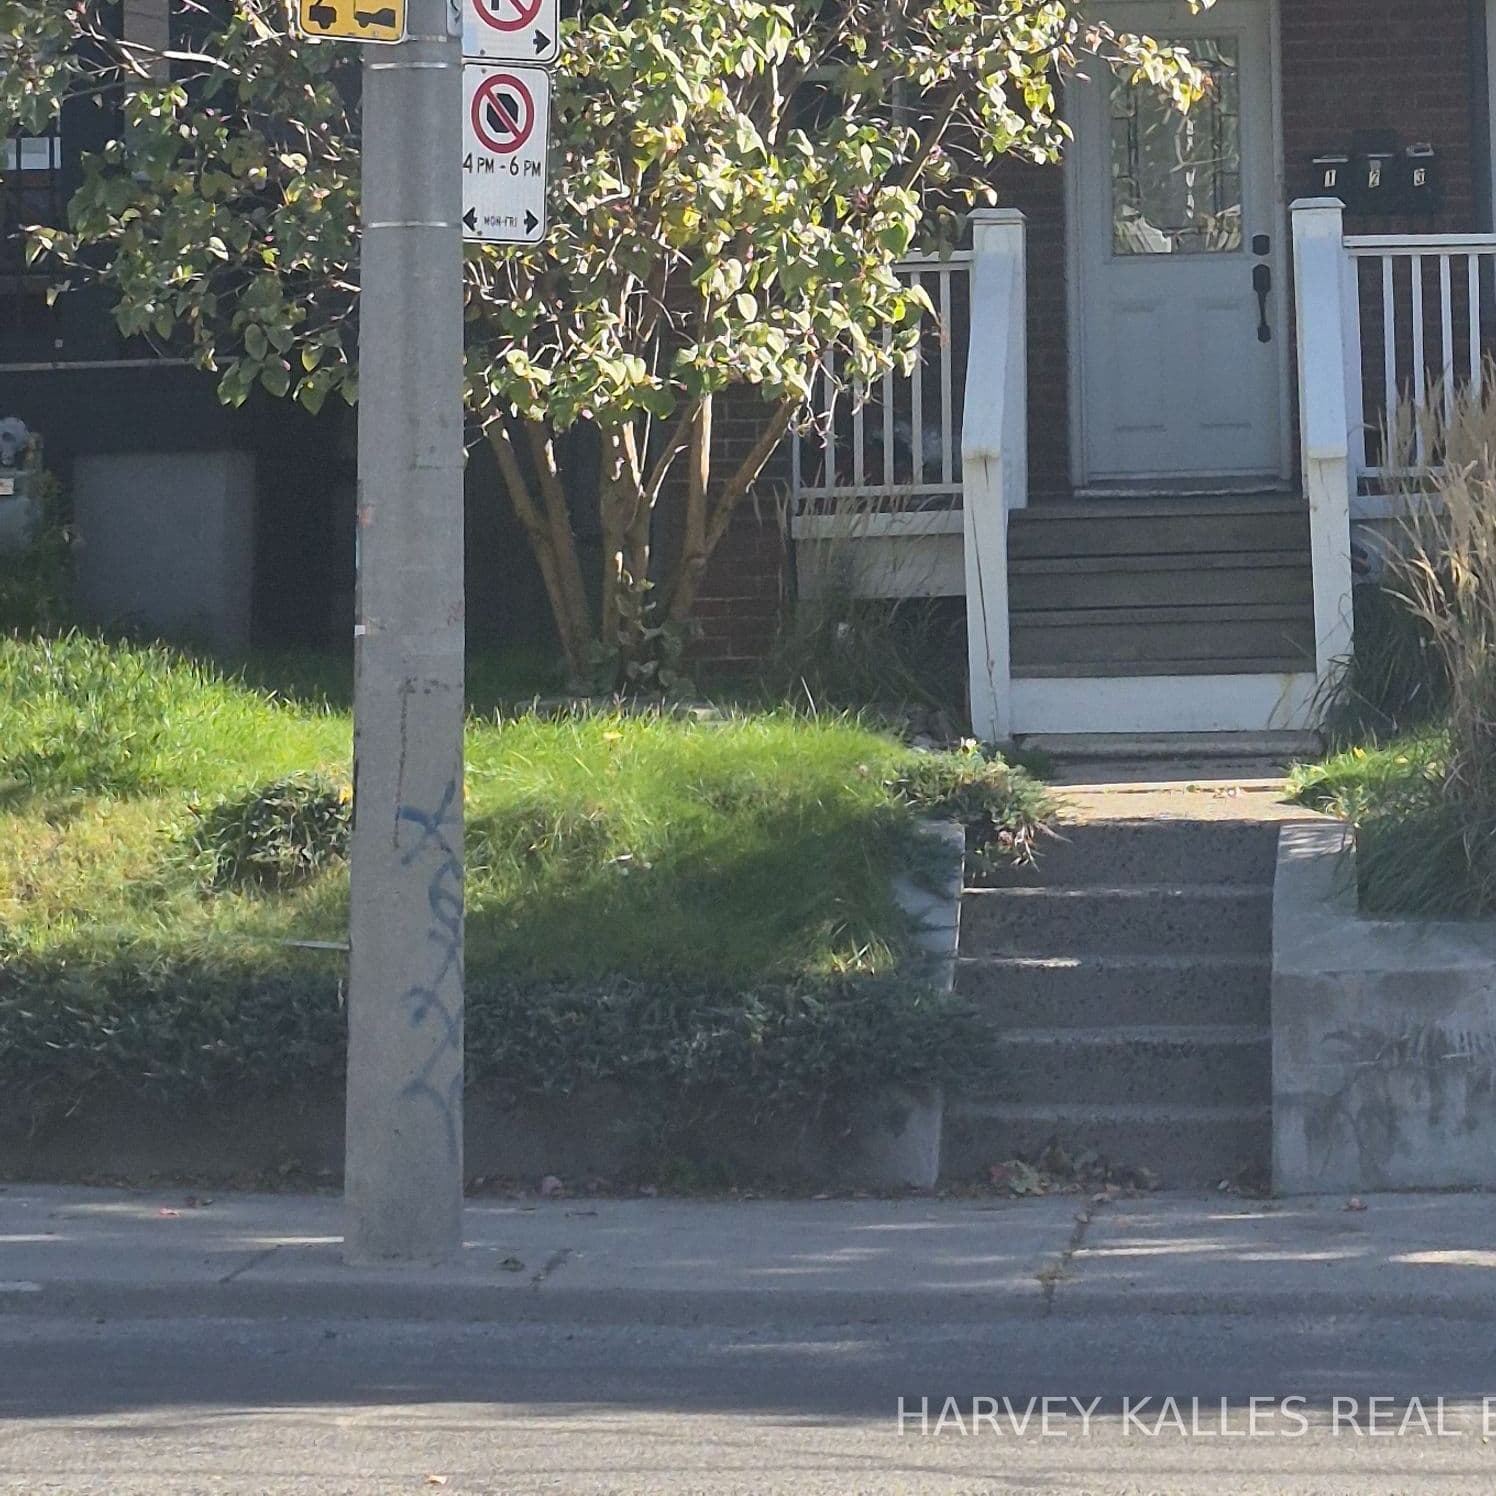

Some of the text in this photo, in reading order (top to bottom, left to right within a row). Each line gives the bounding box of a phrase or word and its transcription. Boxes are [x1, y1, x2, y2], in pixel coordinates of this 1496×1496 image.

[462, 152, 473, 174] 4
[477, 156, 494, 174] PM
[509, 156, 519, 176] 6
[523, 160, 541, 177] PM
